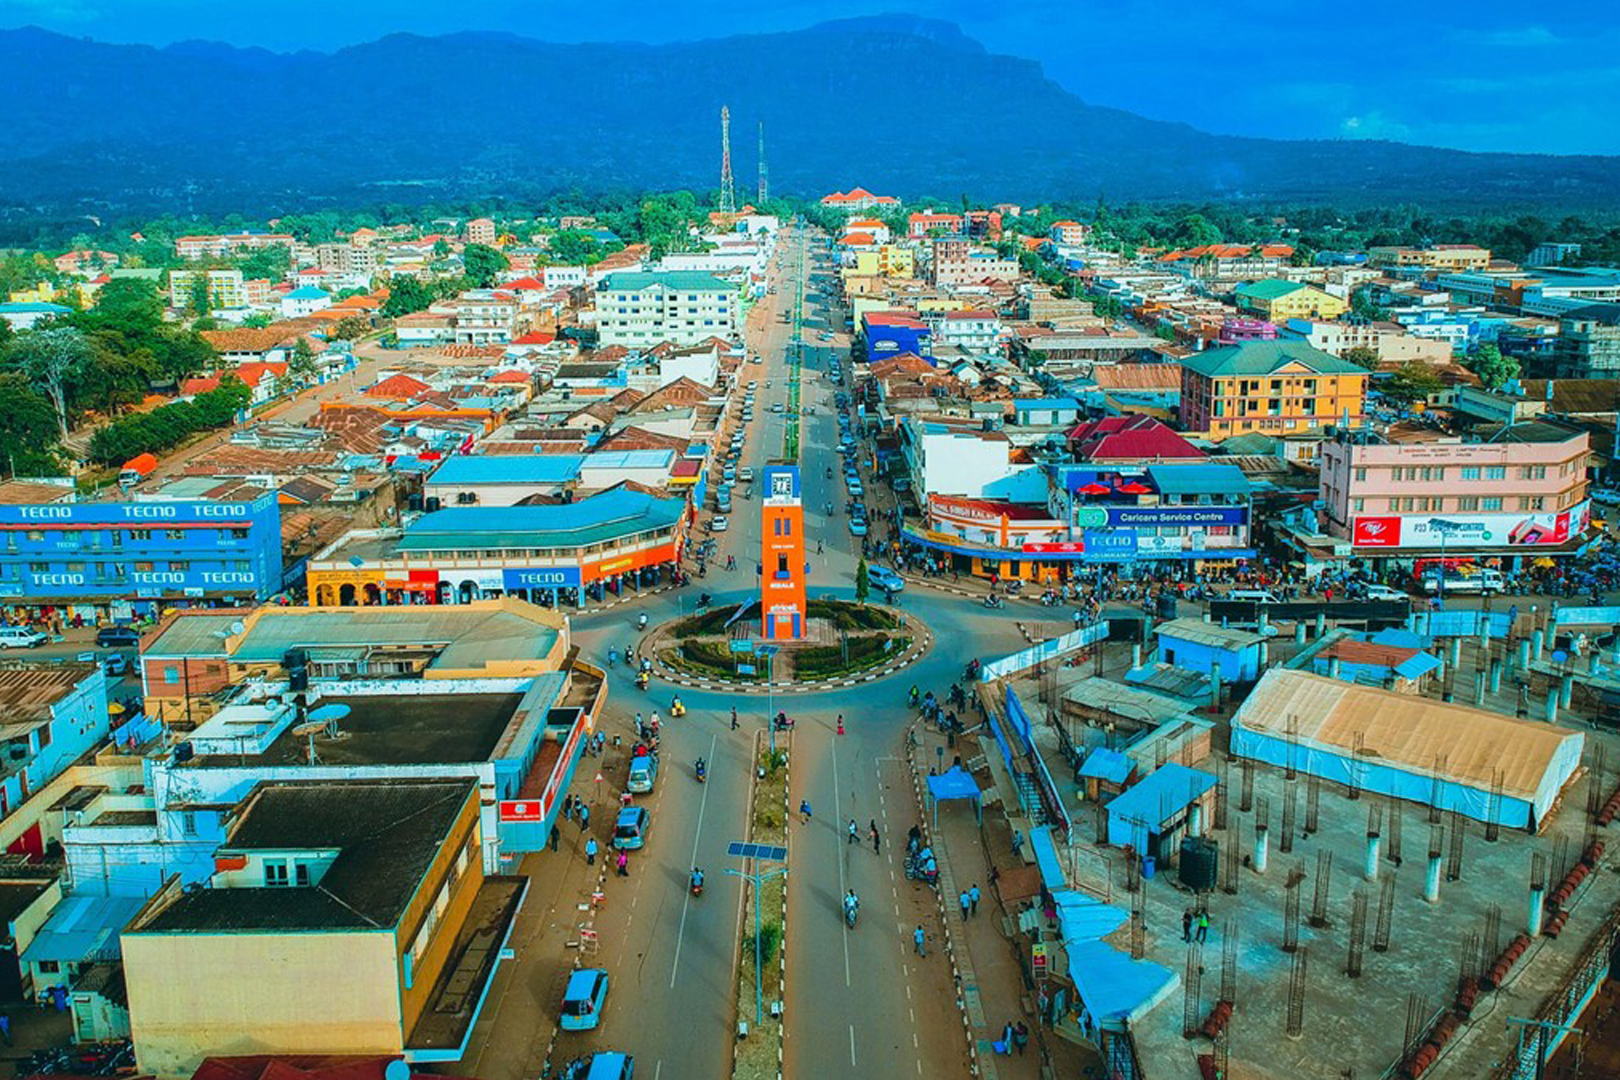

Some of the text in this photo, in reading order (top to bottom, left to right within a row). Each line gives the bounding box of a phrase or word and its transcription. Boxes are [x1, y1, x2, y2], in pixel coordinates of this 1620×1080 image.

[19, 506, 72, 518] TECNO
[122, 506, 176, 518] TECNO
[192, 504, 246, 516] TECNO
[1120, 512, 1223, 522] Caricare Service Centre
[31, 573, 84, 585] TECNO
[132, 571, 185, 583] TECNO
[201, 571, 255, 583] TECNO
[519, 572, 565, 585] TECNO
